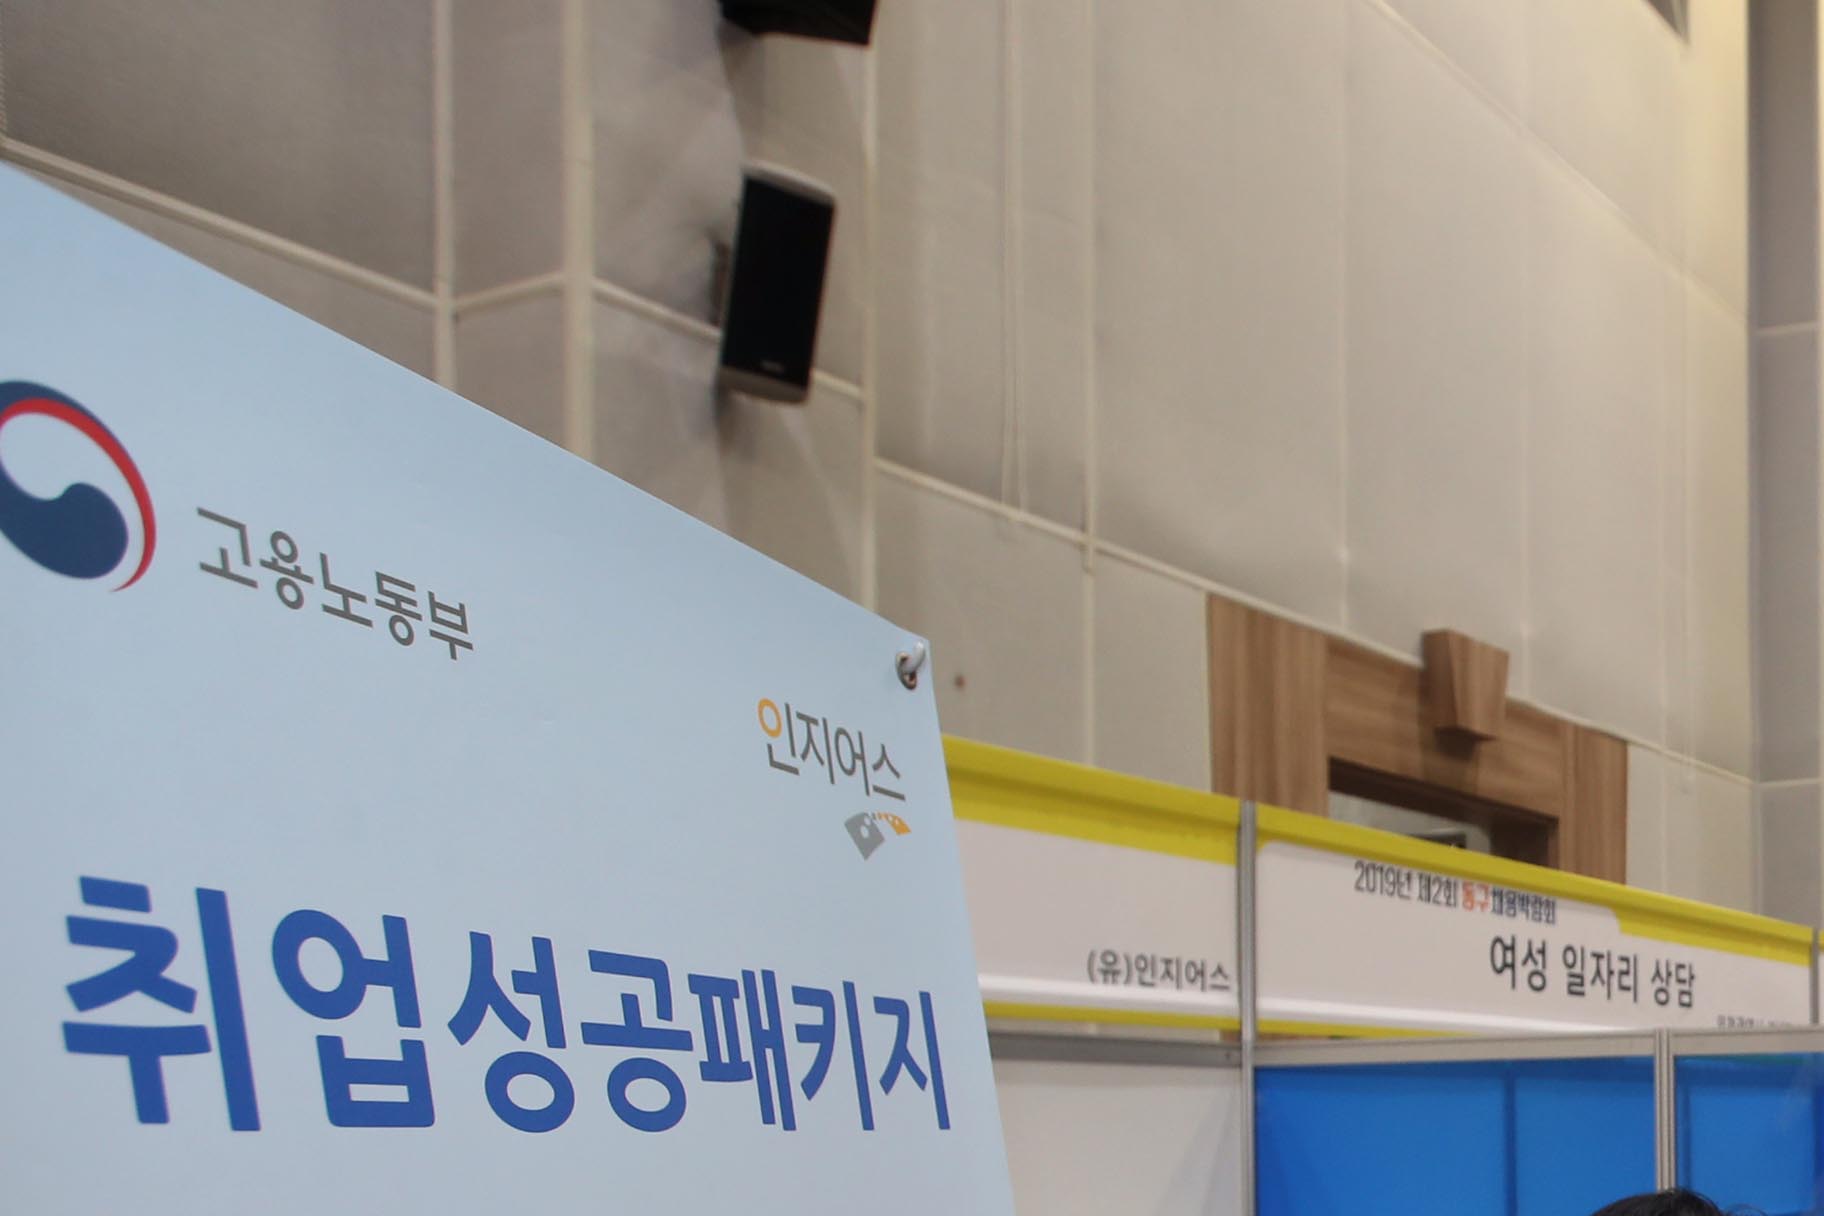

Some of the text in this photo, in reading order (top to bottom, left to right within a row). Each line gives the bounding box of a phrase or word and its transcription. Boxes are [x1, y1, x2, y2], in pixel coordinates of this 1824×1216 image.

[196, 506, 474, 661] 고용노동부
[757, 698, 907, 802] 인지어스
[1354, 859, 1411, 900] 2019년
[1417, 872, 1458, 908] 제2회
[61, 875, 951, 1133] 취업성공패키지
[1087, 949, 1230, 992] (유)인지어스
[1489, 934, 1696, 1009] 여성 일자리 상담
